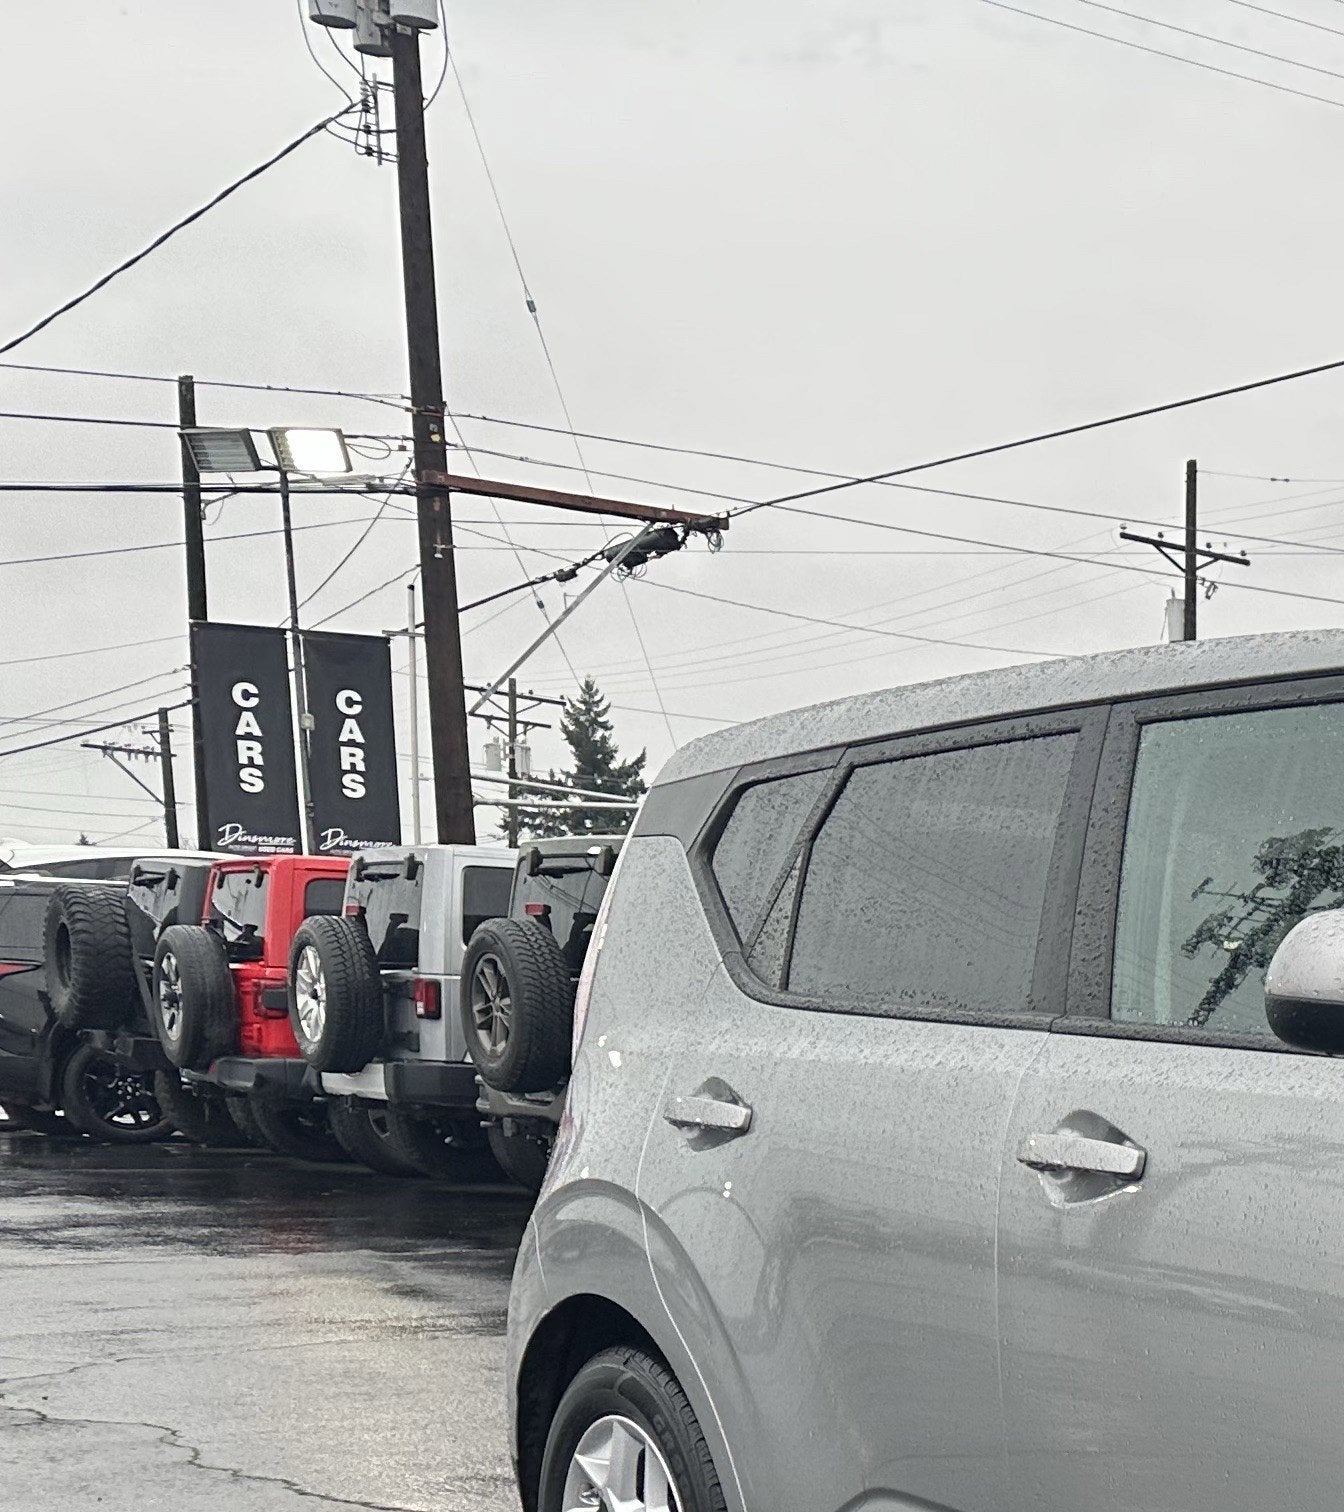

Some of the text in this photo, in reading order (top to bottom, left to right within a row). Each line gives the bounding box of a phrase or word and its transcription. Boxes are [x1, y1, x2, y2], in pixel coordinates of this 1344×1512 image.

[231, 681, 265, 794] CARS
[335, 689, 366, 799] CARS
[217, 823, 297, 846] Dinsmore
